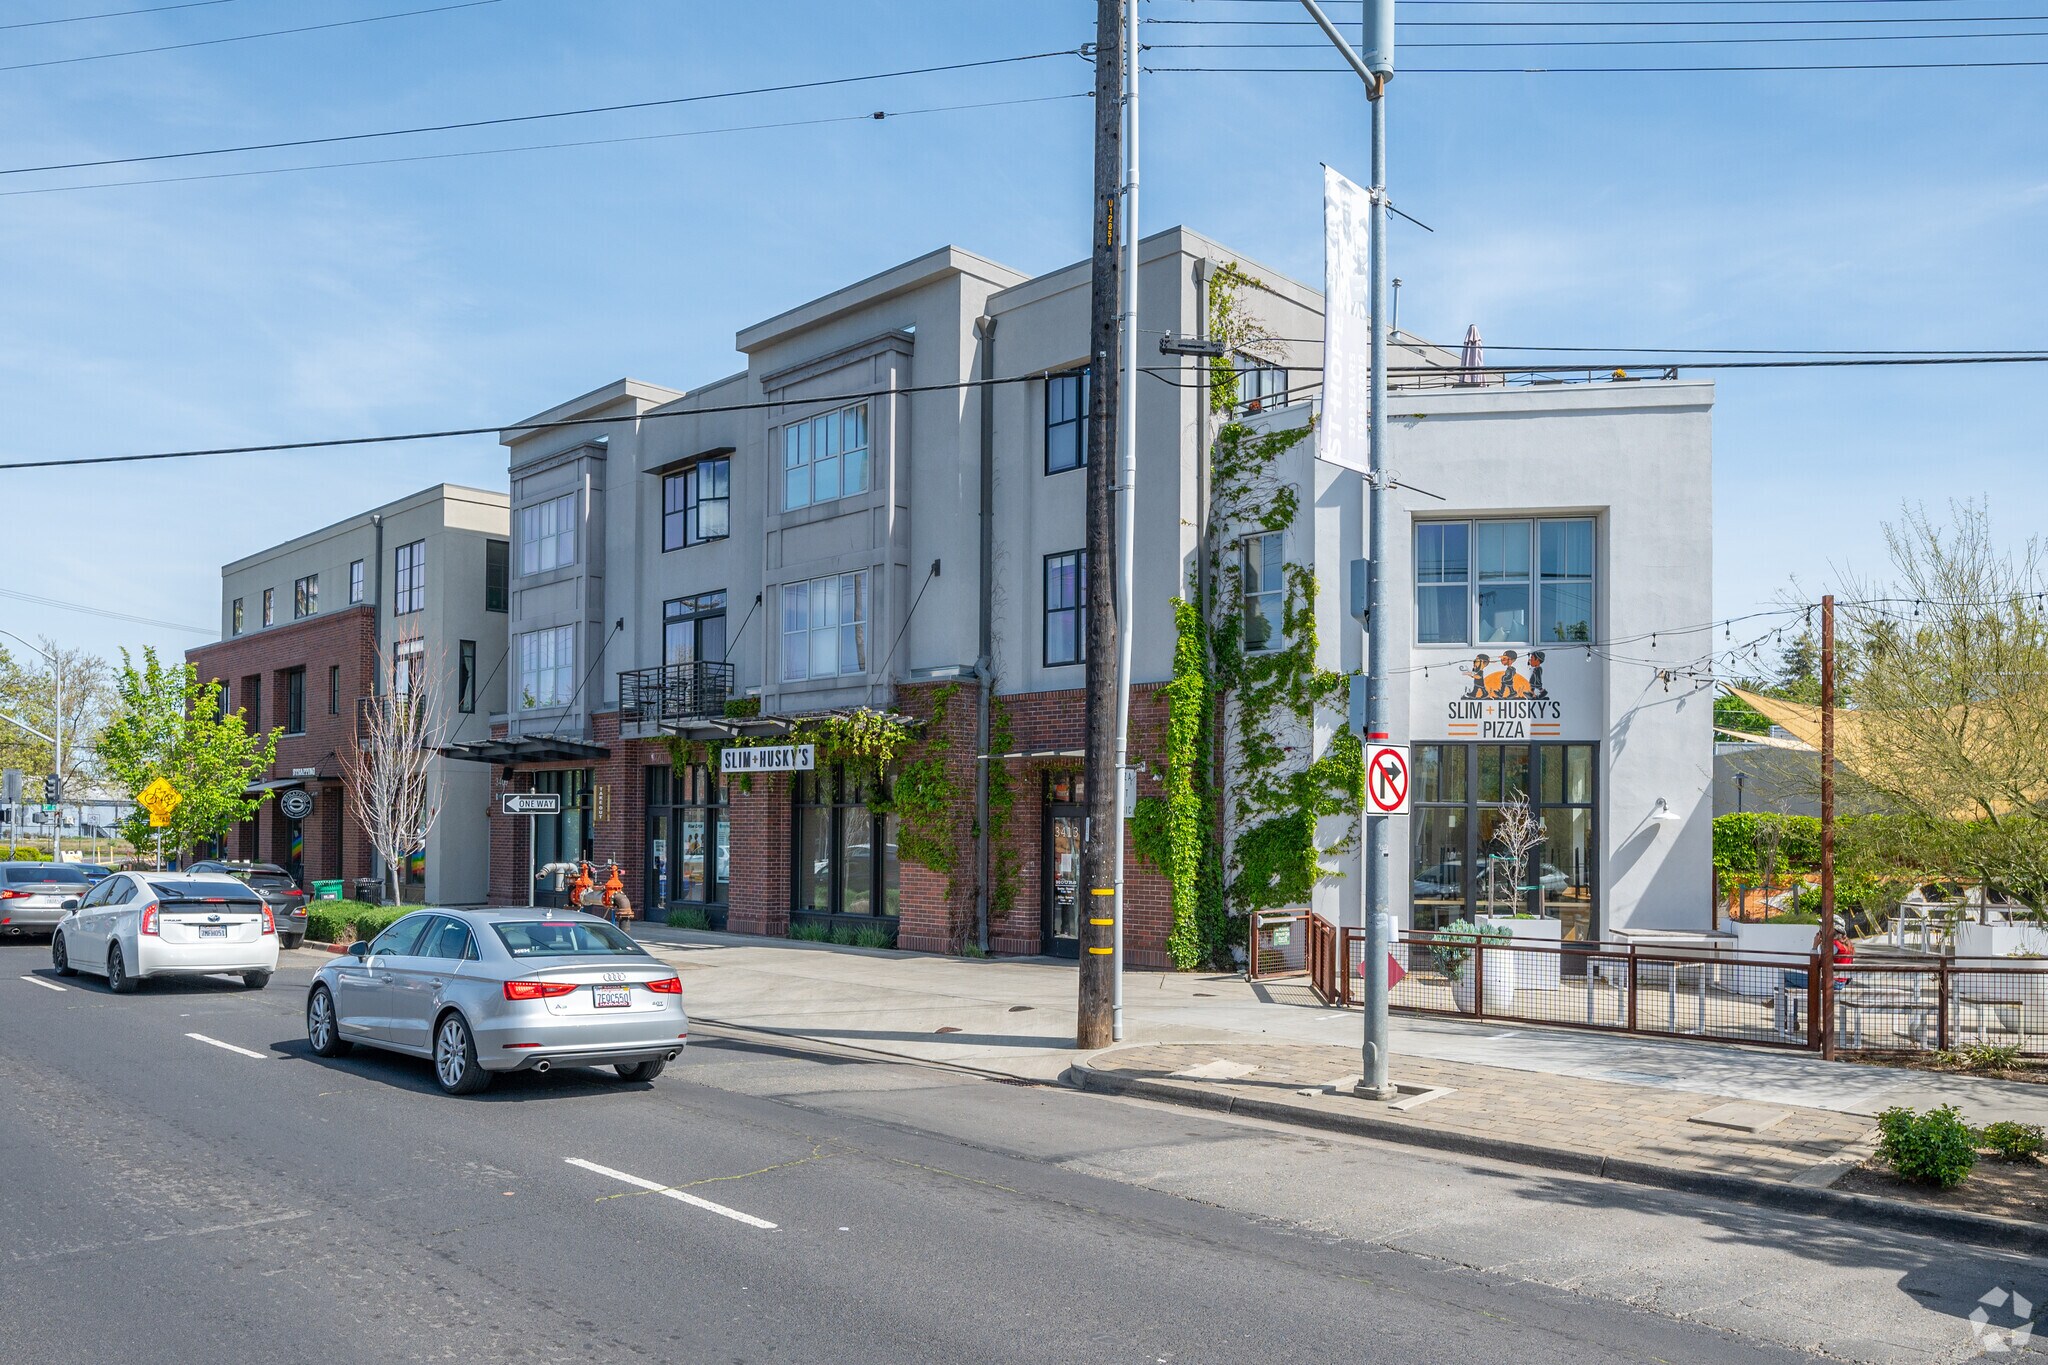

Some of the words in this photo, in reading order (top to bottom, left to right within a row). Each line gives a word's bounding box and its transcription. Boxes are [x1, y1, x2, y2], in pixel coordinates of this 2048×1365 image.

[1348, 352, 1357, 411] YEARS
[1448, 701, 1483, 719] SLIM
[1498, 700, 1561, 719] HUSKY'S
[1483, 721, 1525, 738] PIZZA
[519, 800, 535, 808] ONE
[536, 800, 554, 808] WAY
[1055, 826, 1079, 838] 3413
